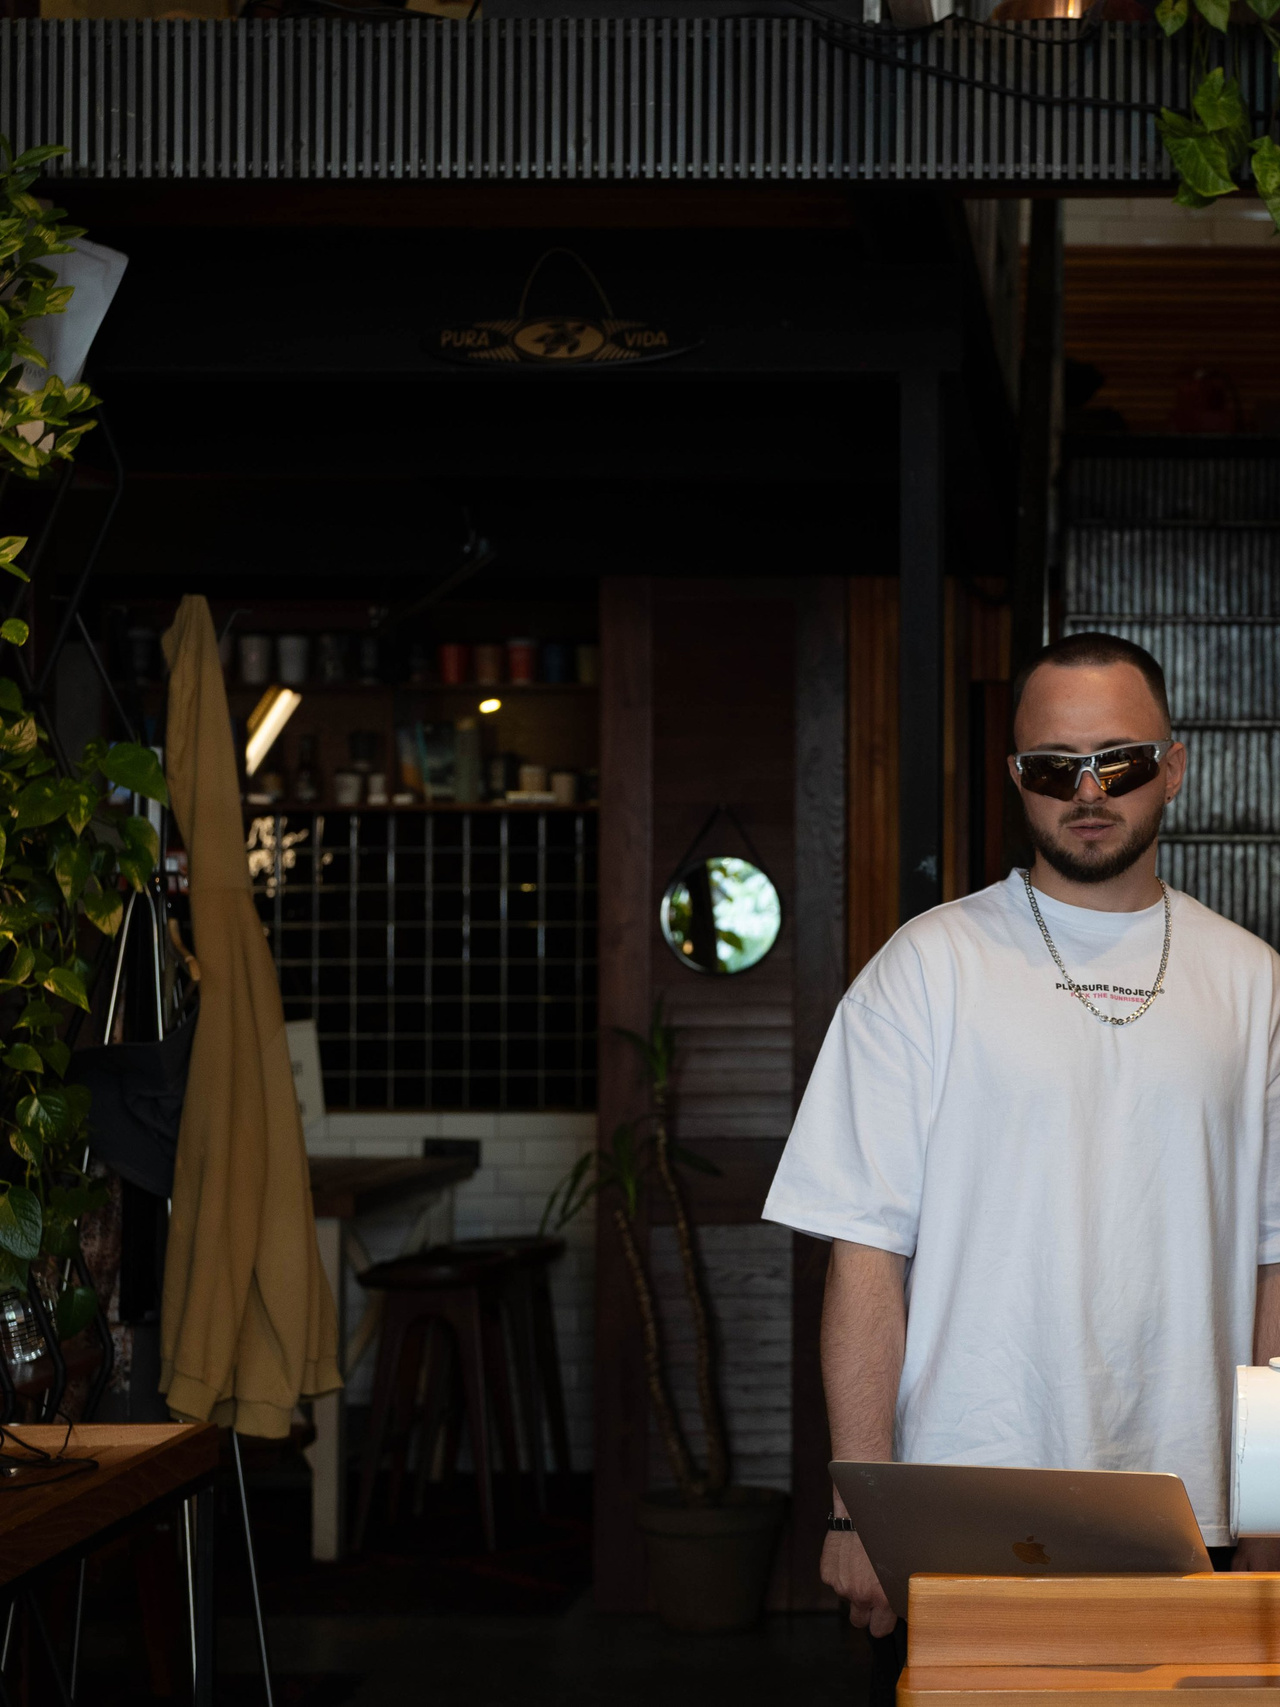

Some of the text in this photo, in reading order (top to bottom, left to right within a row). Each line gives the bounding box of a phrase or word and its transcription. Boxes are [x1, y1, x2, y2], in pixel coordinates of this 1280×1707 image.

[440, 330, 669, 348] PURA VIDA
[1112, 985, 1157, 998] PROJEC
